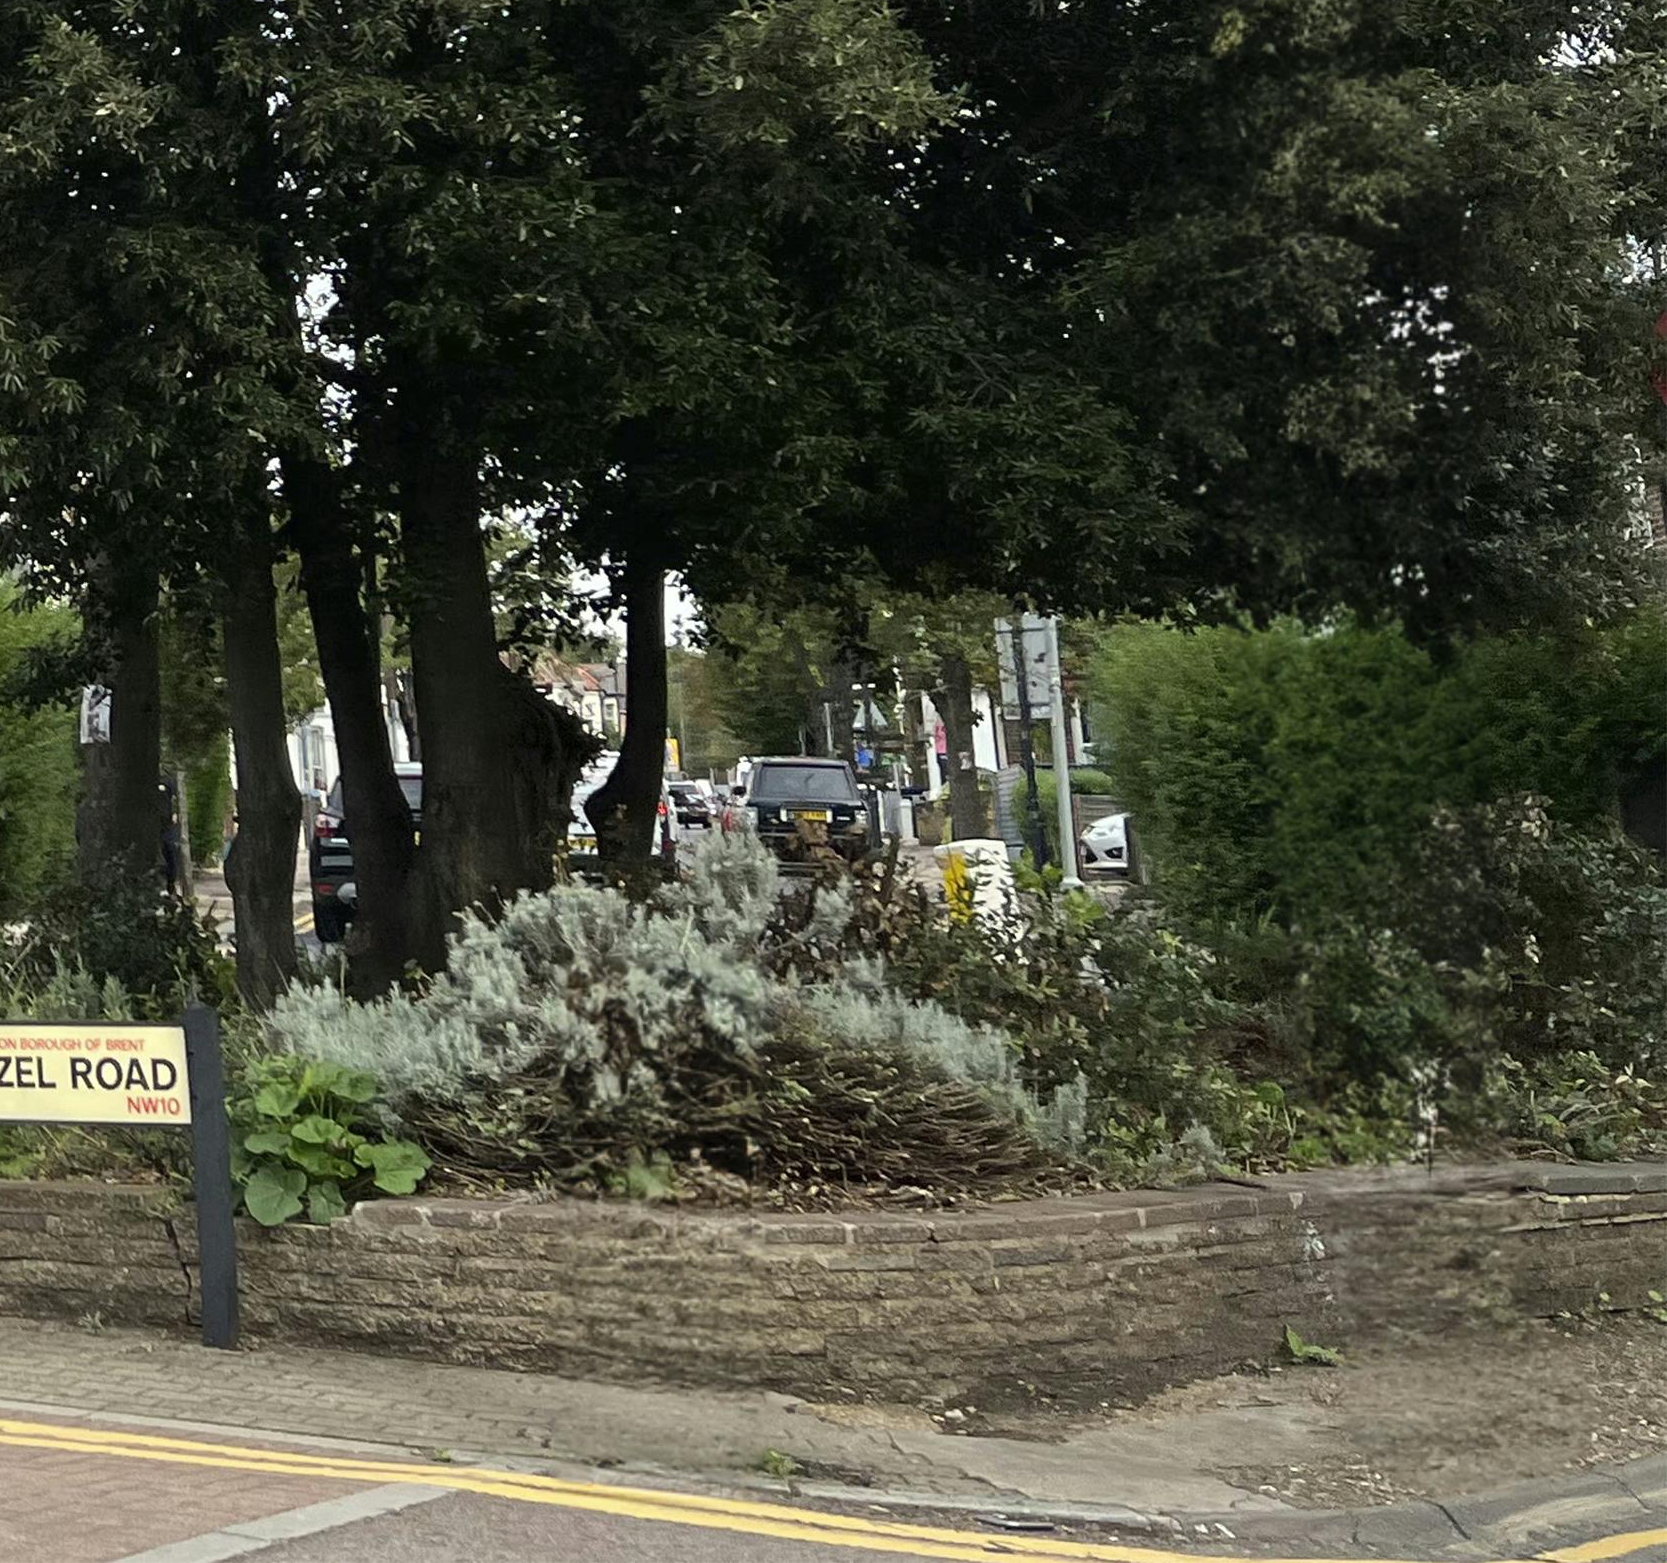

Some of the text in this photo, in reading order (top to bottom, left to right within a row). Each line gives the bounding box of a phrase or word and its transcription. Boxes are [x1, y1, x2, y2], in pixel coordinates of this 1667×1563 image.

[20, 1038, 82, 1051] BOROUGH
[85, 1038, 101, 1051] OF
[106, 1039, 145, 1052] BRENT
[70, 1056, 177, 1091] ROAD
[126, 1096, 181, 1115] NW10
